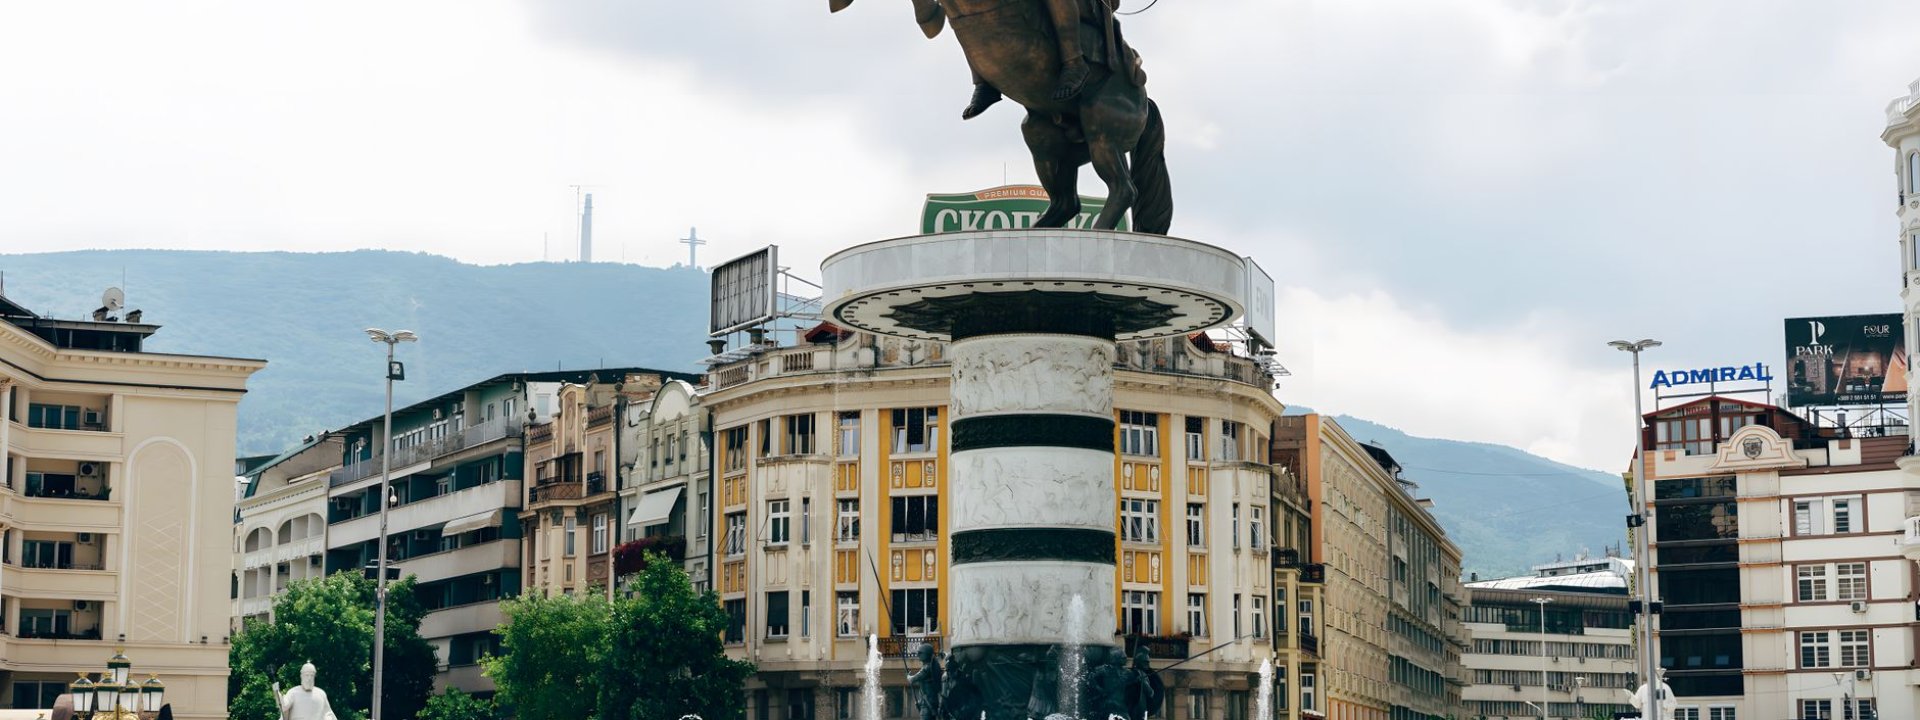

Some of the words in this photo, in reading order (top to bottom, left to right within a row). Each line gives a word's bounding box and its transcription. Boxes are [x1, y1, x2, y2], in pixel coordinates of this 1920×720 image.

[984, 189, 1026, 199] PREMIUM
[1864, 324, 1890, 335] FOUR
[1796, 344, 1834, 356] PARK
[1650, 362, 1774, 389] ADMIRAL
